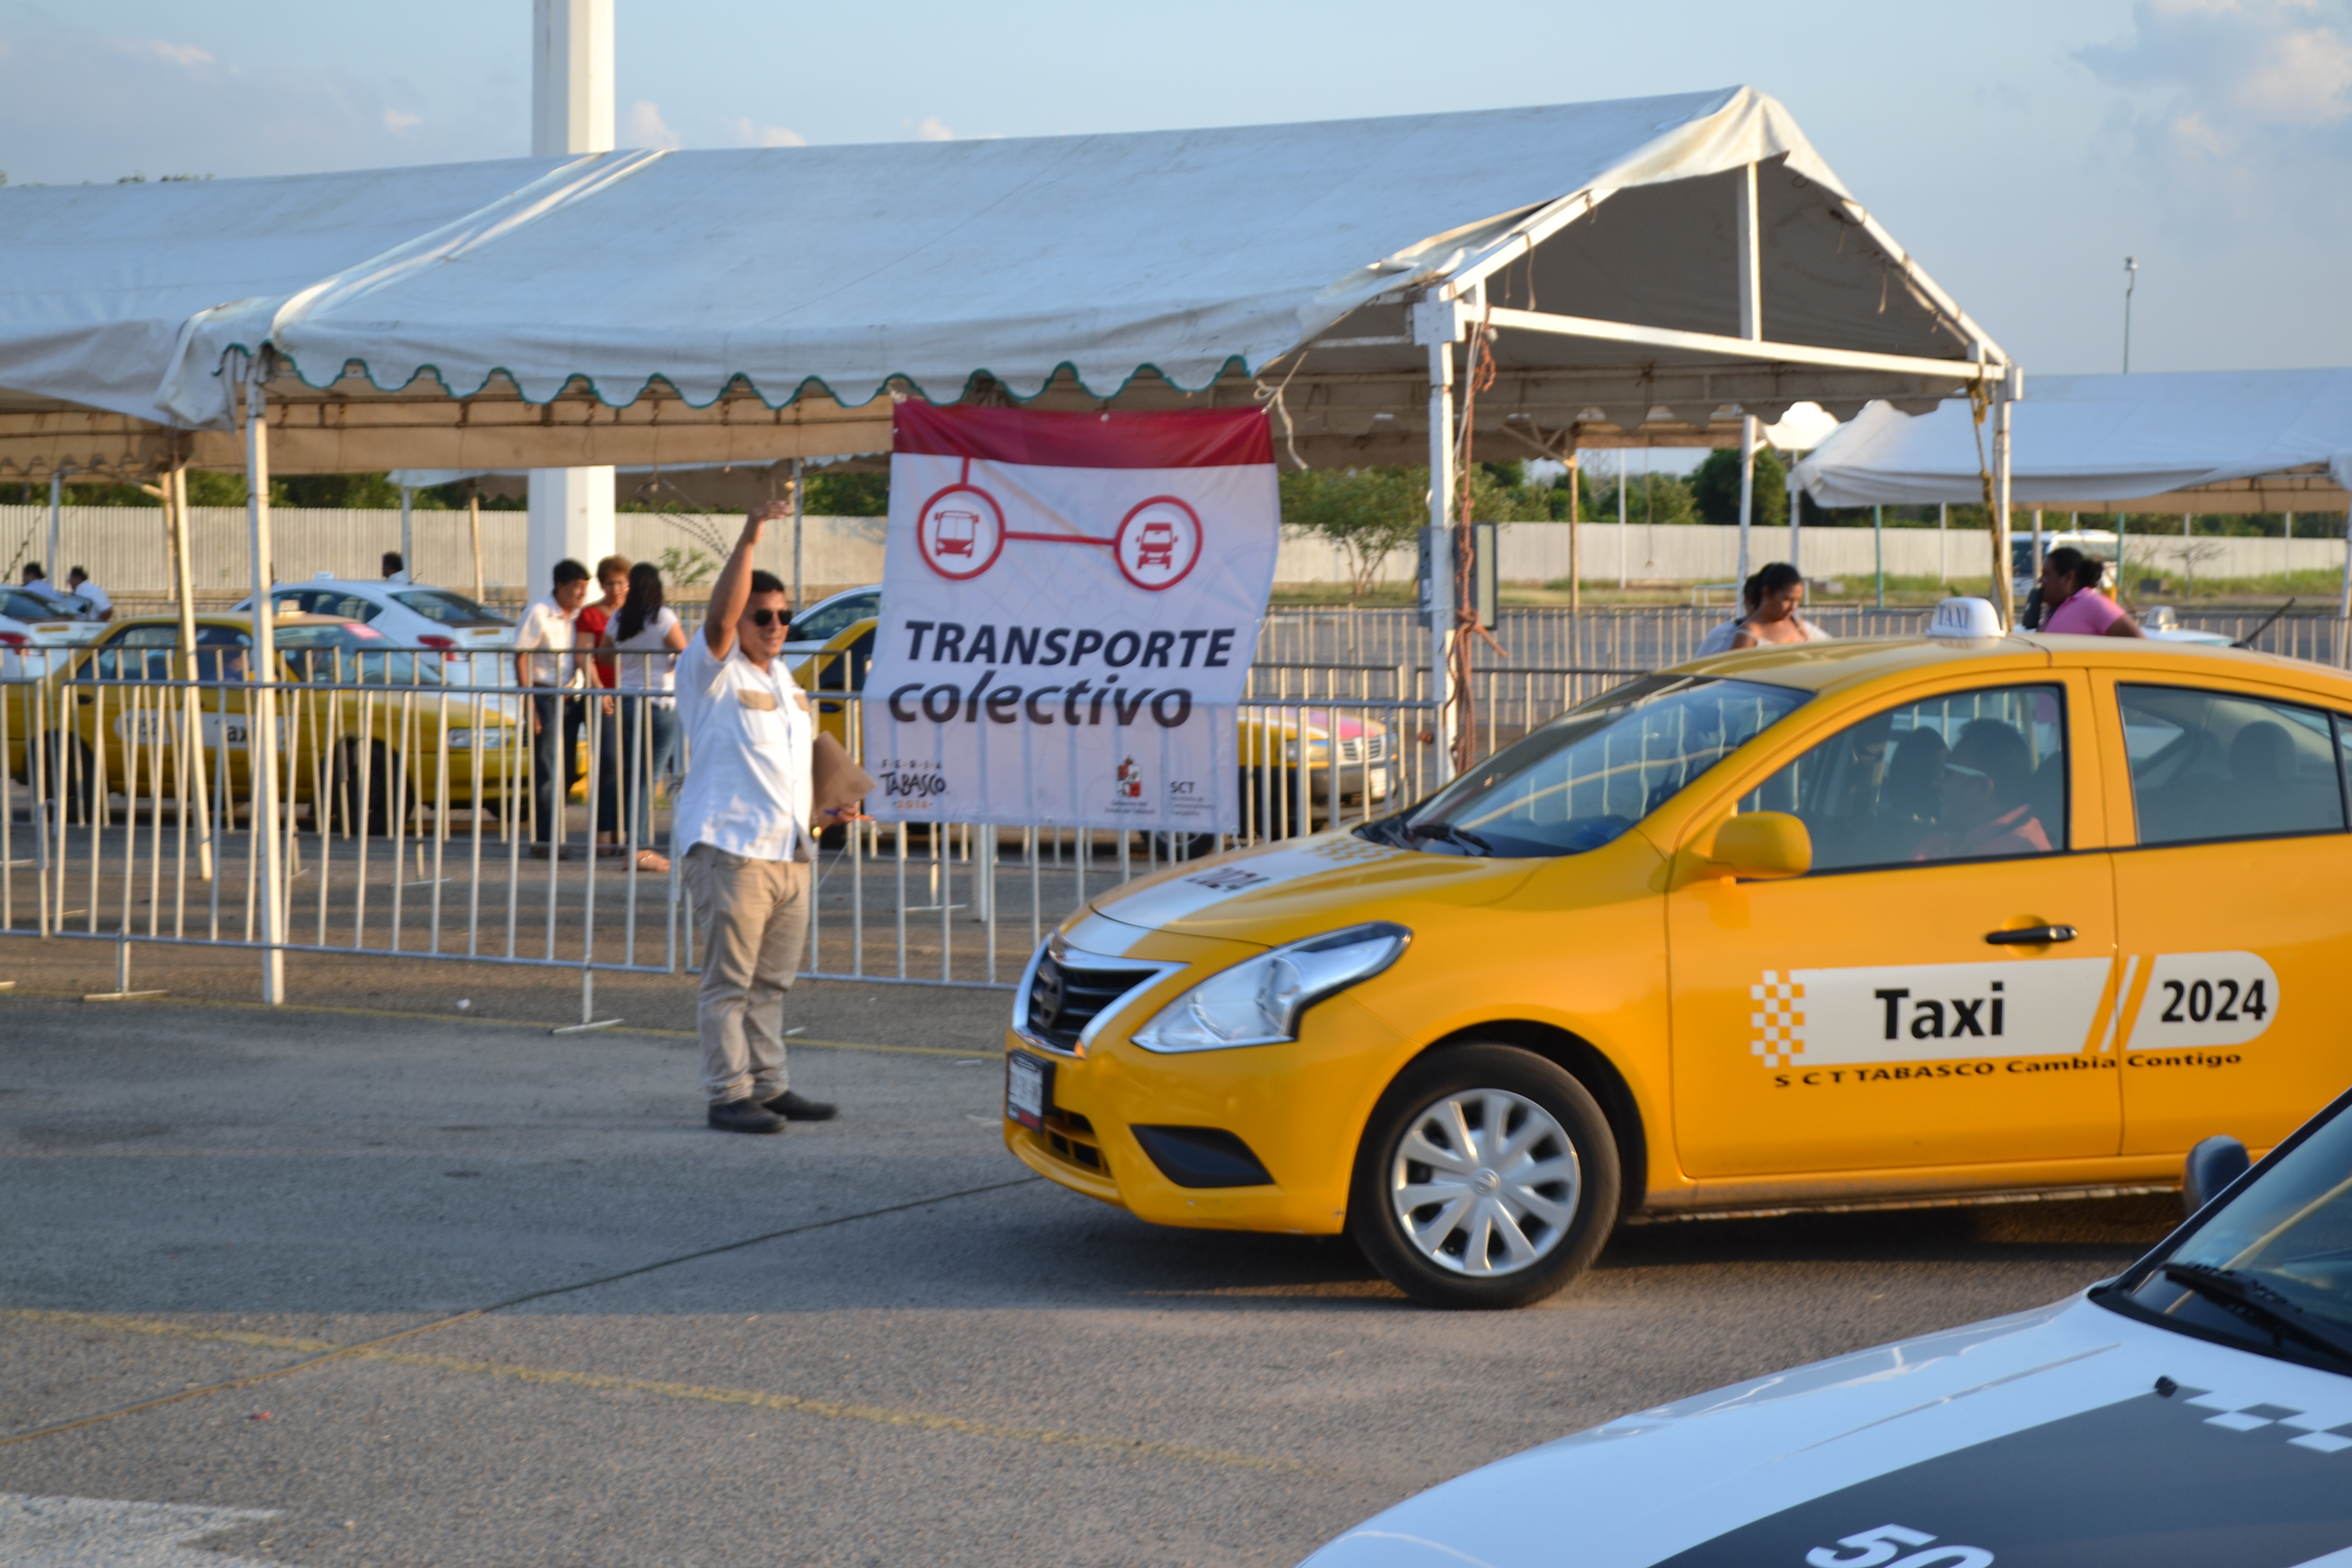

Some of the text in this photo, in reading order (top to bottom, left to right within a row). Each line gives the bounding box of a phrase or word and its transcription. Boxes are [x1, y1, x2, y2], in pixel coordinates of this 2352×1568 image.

[904, 620, 1236, 667] TRANSPORTE
[888, 670, 1192, 728] colectivo
[879, 771, 947, 798] TABASCO
[1169, 781, 1195, 794] SCT
[1874, 978, 2266, 1040] Taxi 2024
[1774, 1074, 1791, 1088] S
[1802, 1072, 1821, 1085] C
[1854, 1063, 1995, 1082] TABASCO
[2006, 1055, 2117, 1073] Cambia
[2127, 1051, 2242, 1068] Contigo
